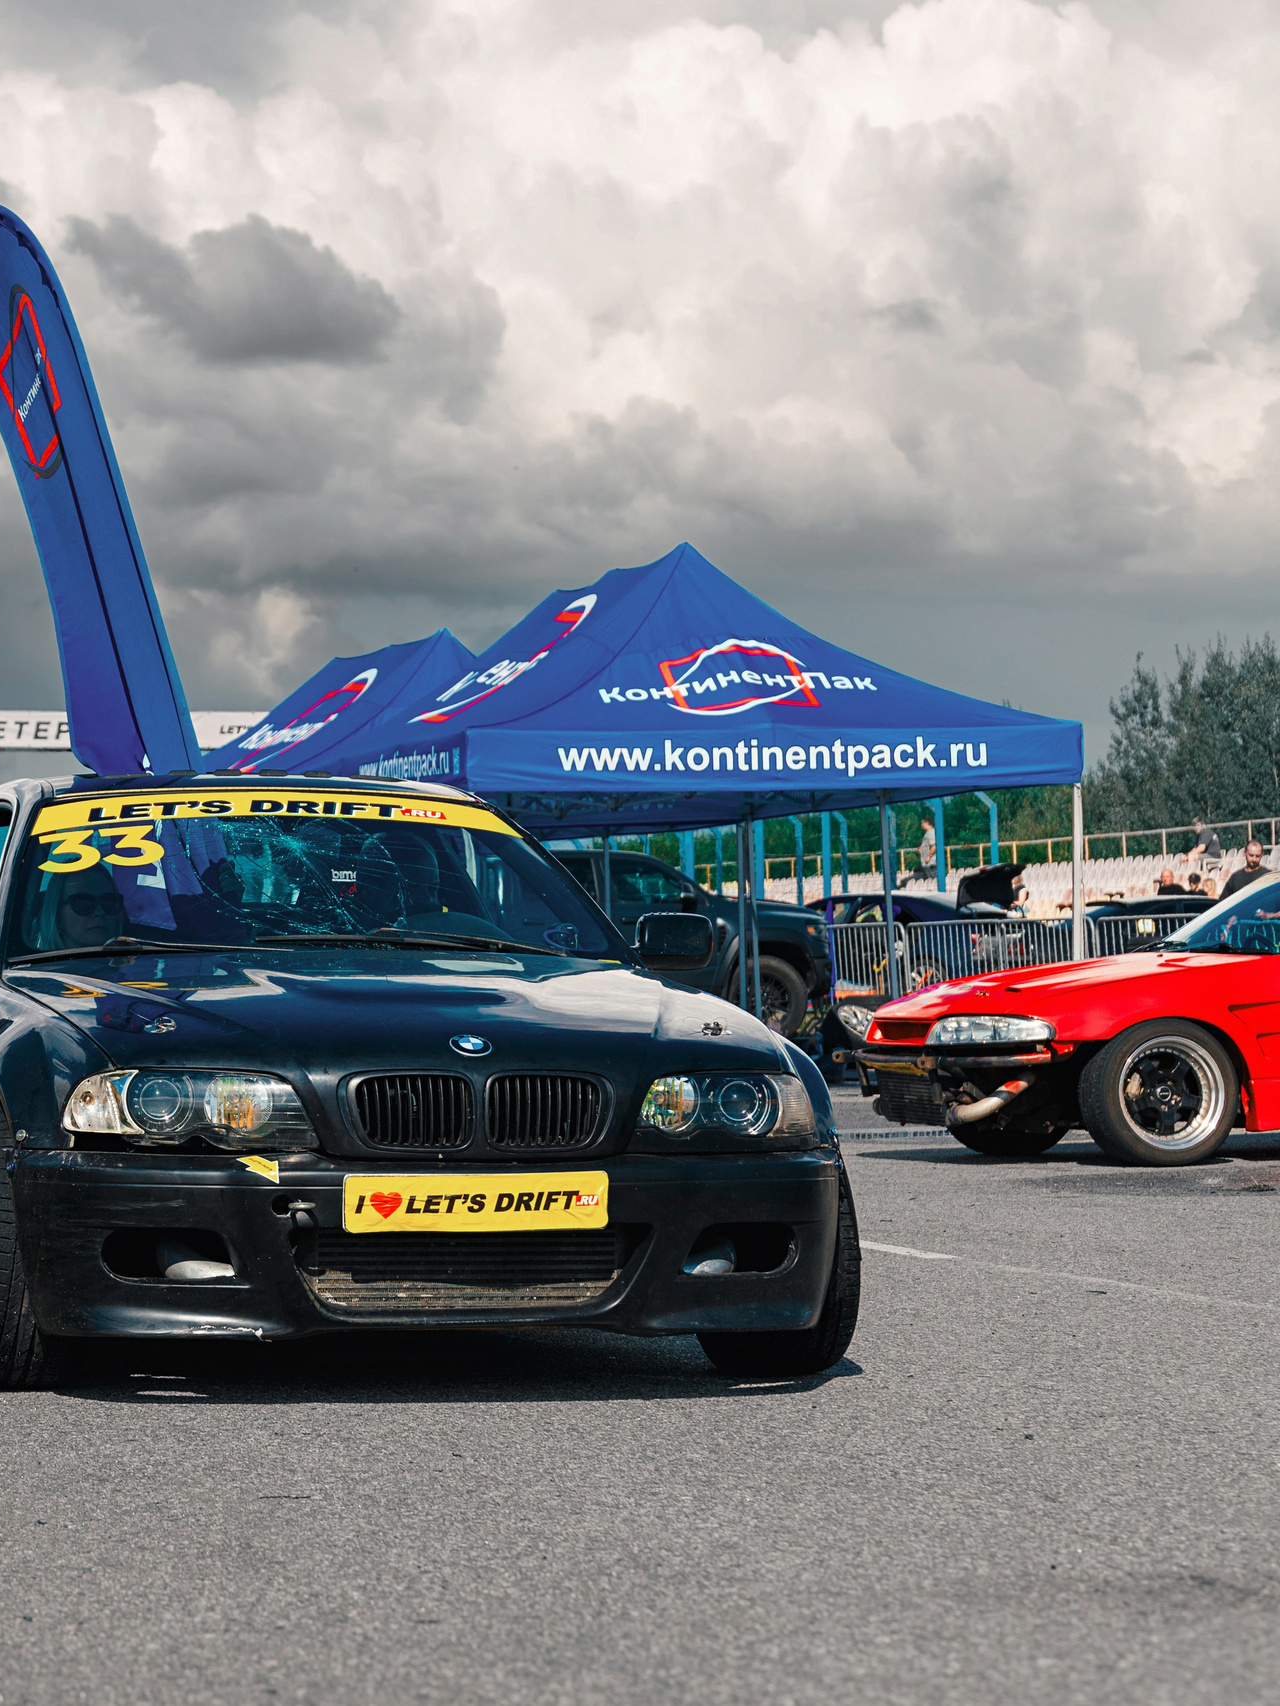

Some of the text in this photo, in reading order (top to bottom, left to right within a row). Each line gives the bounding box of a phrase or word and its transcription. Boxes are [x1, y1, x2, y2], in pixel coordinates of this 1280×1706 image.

[599, 667, 878, 702] КонтинентПак
[359, 745, 449, 782] wwwkontinentpack.ru
[557, 737, 988, 777] www.kontinentpack.ru
[88, 801, 233, 822] LET'S
[37, 824, 166, 873] 33
[405, 1193, 486, 1213] LET'S
